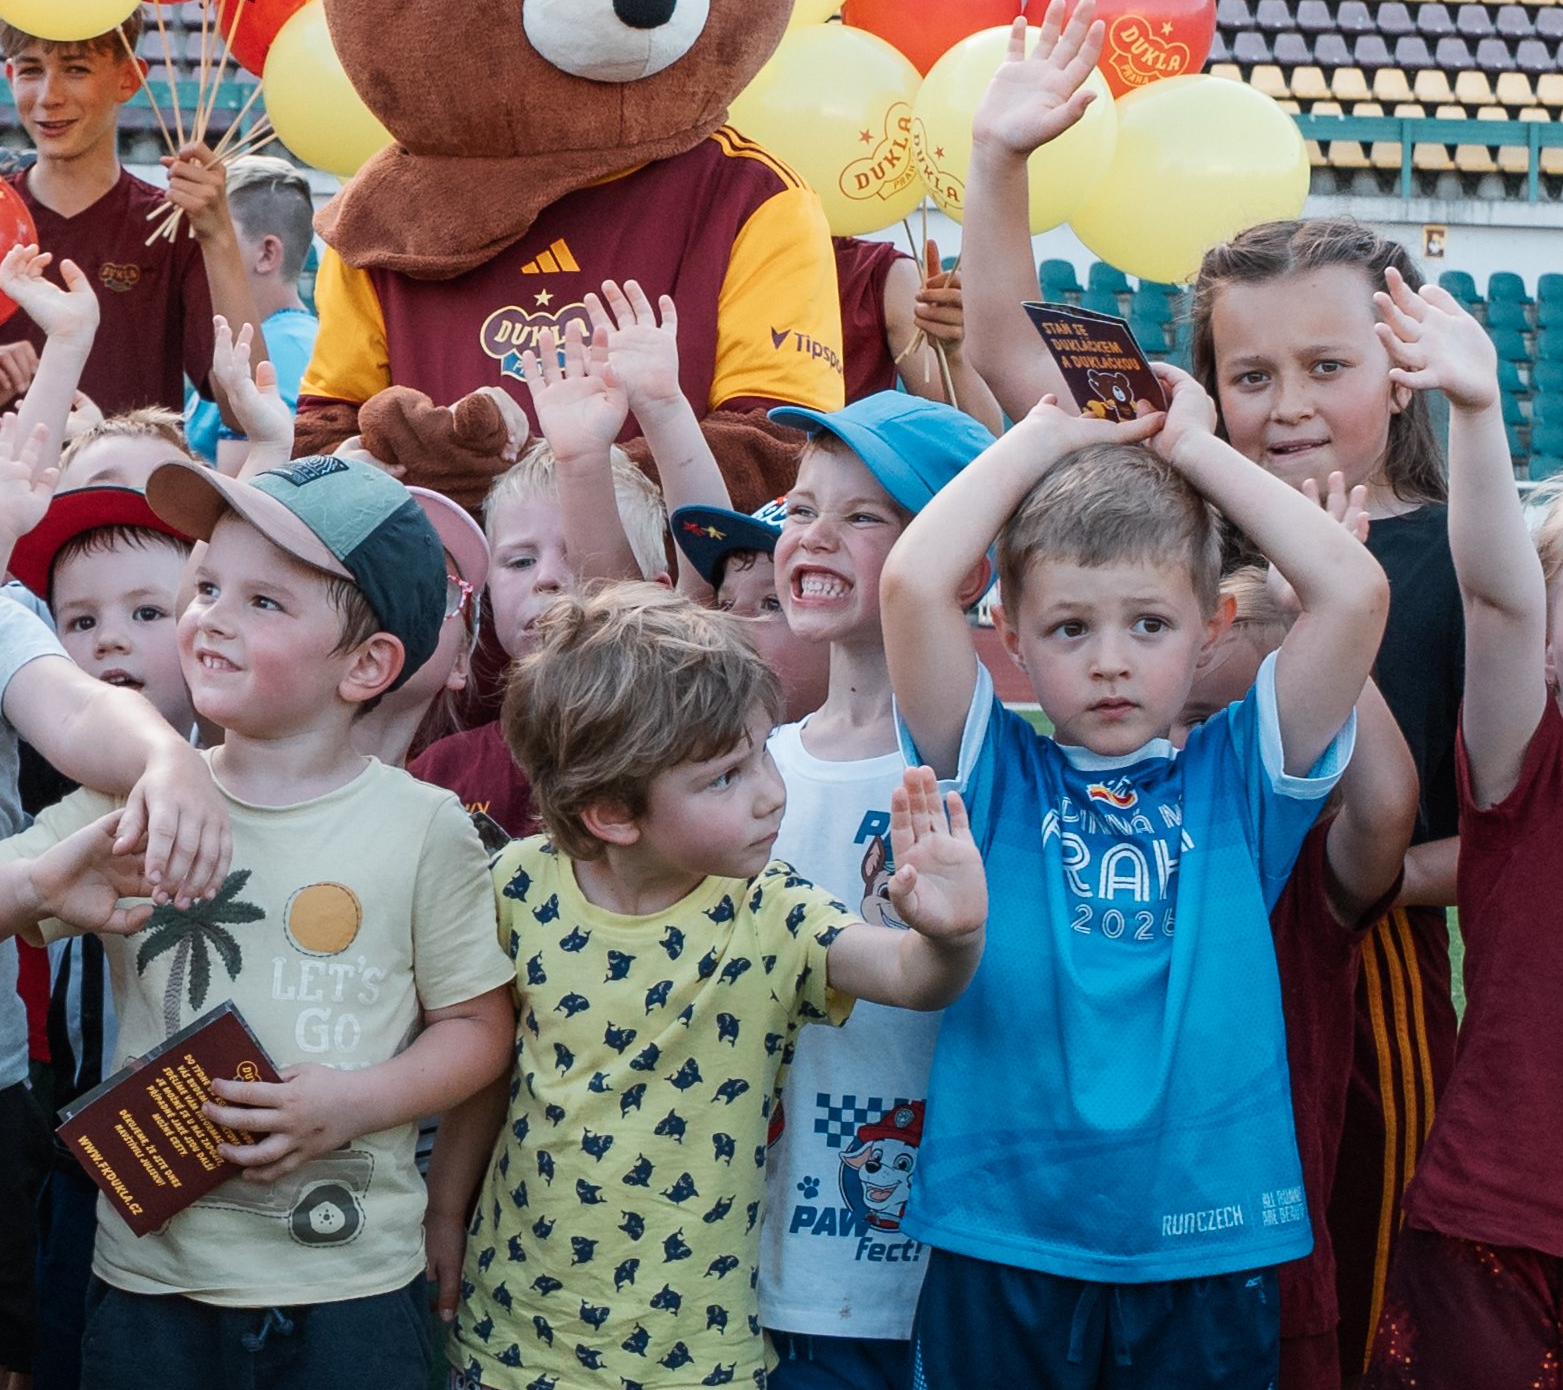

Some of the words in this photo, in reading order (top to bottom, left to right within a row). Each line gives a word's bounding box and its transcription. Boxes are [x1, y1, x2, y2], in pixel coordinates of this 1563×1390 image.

[1120, 25, 1181, 71] DUKLA
[854, 114, 912, 192] DUKLA
[1071, 903, 1176, 941] 2026
[271, 957, 386, 1004] LET'S
[294, 1007, 362, 1054] GO
[177, 1064, 190, 1080] VÁS
[186, 1074, 209, 1103] BUDEM
[183, 1053, 196, 1066] DO
[192, 1064, 212, 1088] TÝDNE
[146, 1084, 176, 1120] PŘÍPADNÉ
[171, 1117, 190, 1137] JAKÉ
[184, 1133, 201, 1156] JSOU
[196, 1151, 217, 1172] DALŠÍ
[151, 1112, 174, 1140] MOŽNÉ
[155, 1077, 167, 1088] JE
[163, 1083, 185, 1110] MOŽNÉ
[179, 1107, 191, 1121] SE
[192, 1125, 205, 1141] NÁS
[185, 1094, 200, 1112] VÁM
[197, 1109, 225, 1145] INFORMAC
[118, 1108, 149, 1147] DĚKUJEME,
[145, 1142, 158, 1156] ŽE
[152, 1151, 169, 1171] JSTE
[164, 1169, 183, 1189] DNES
[77, 1134, 144, 1216] WWW.FKDUKLA.CZ
[788, 1205, 871, 1238] PAW
[855, 1237, 922, 1263] fect!
